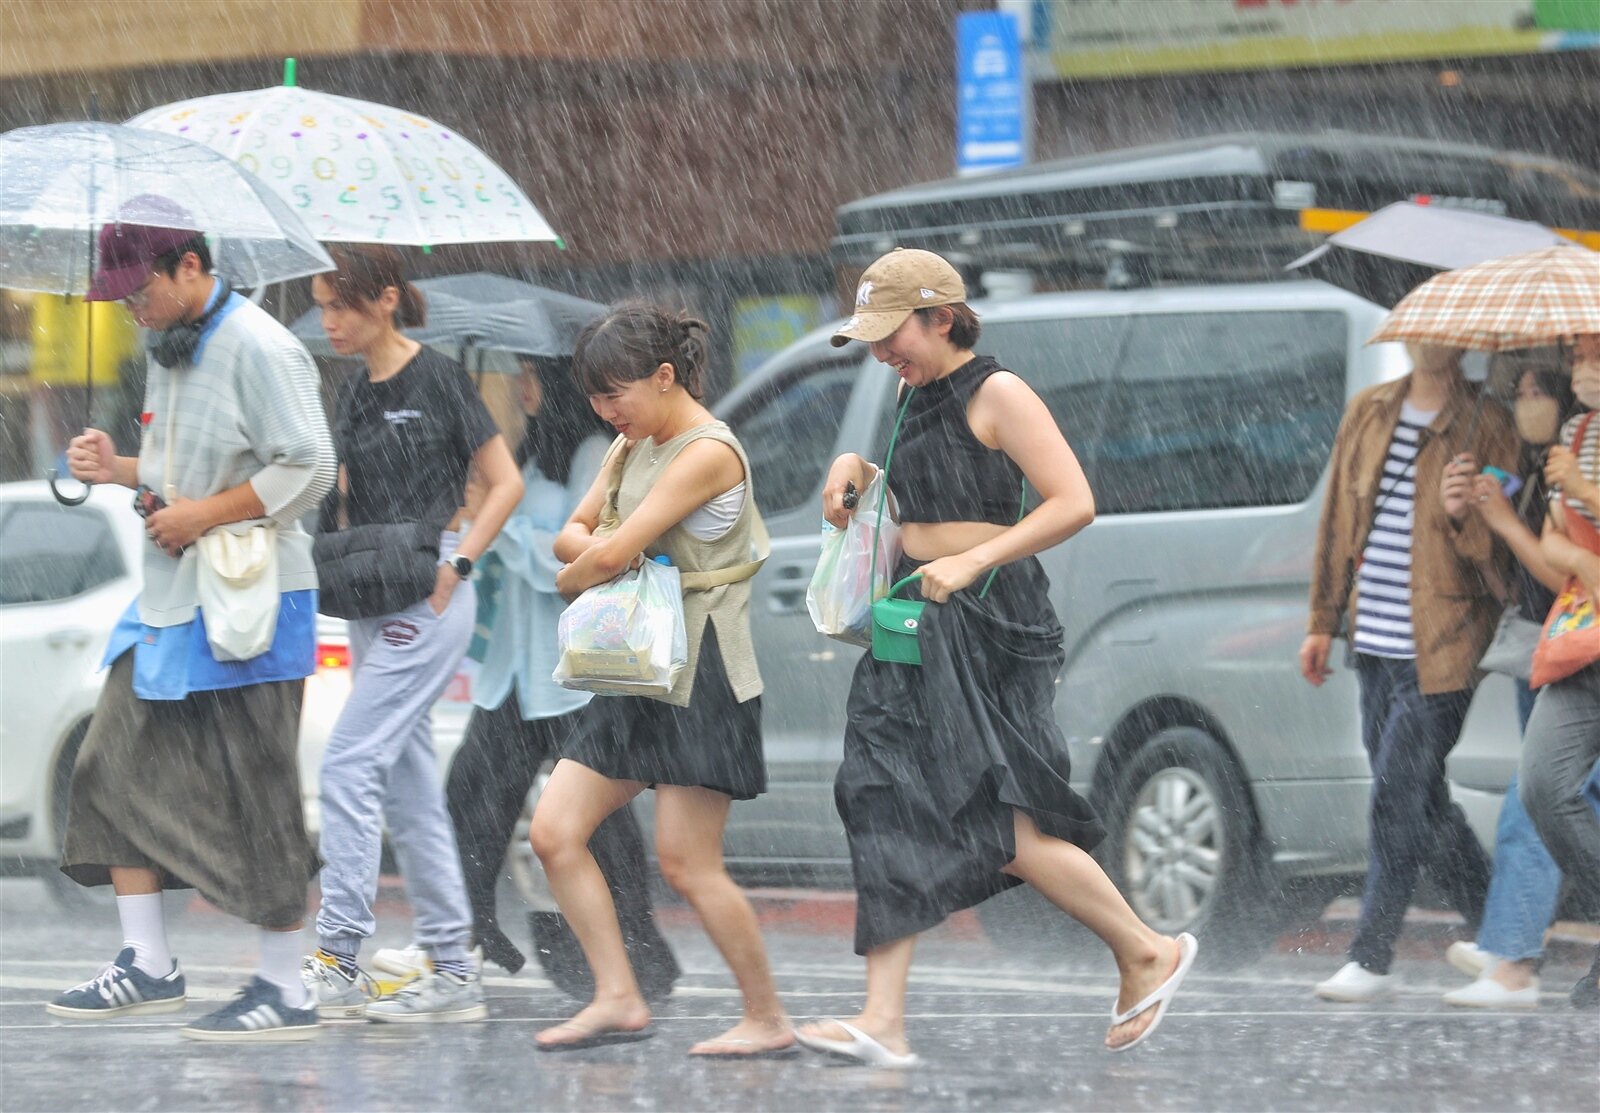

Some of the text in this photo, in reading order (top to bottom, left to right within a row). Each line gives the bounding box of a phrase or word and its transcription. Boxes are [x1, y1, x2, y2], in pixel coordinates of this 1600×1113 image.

[271, 156, 292, 179] 9
[312, 156, 336, 180] 0
[355, 157, 378, 181] 9
[292, 184, 311, 208] 5
[380, 185, 402, 210] 5
[368, 214, 390, 238] 7
